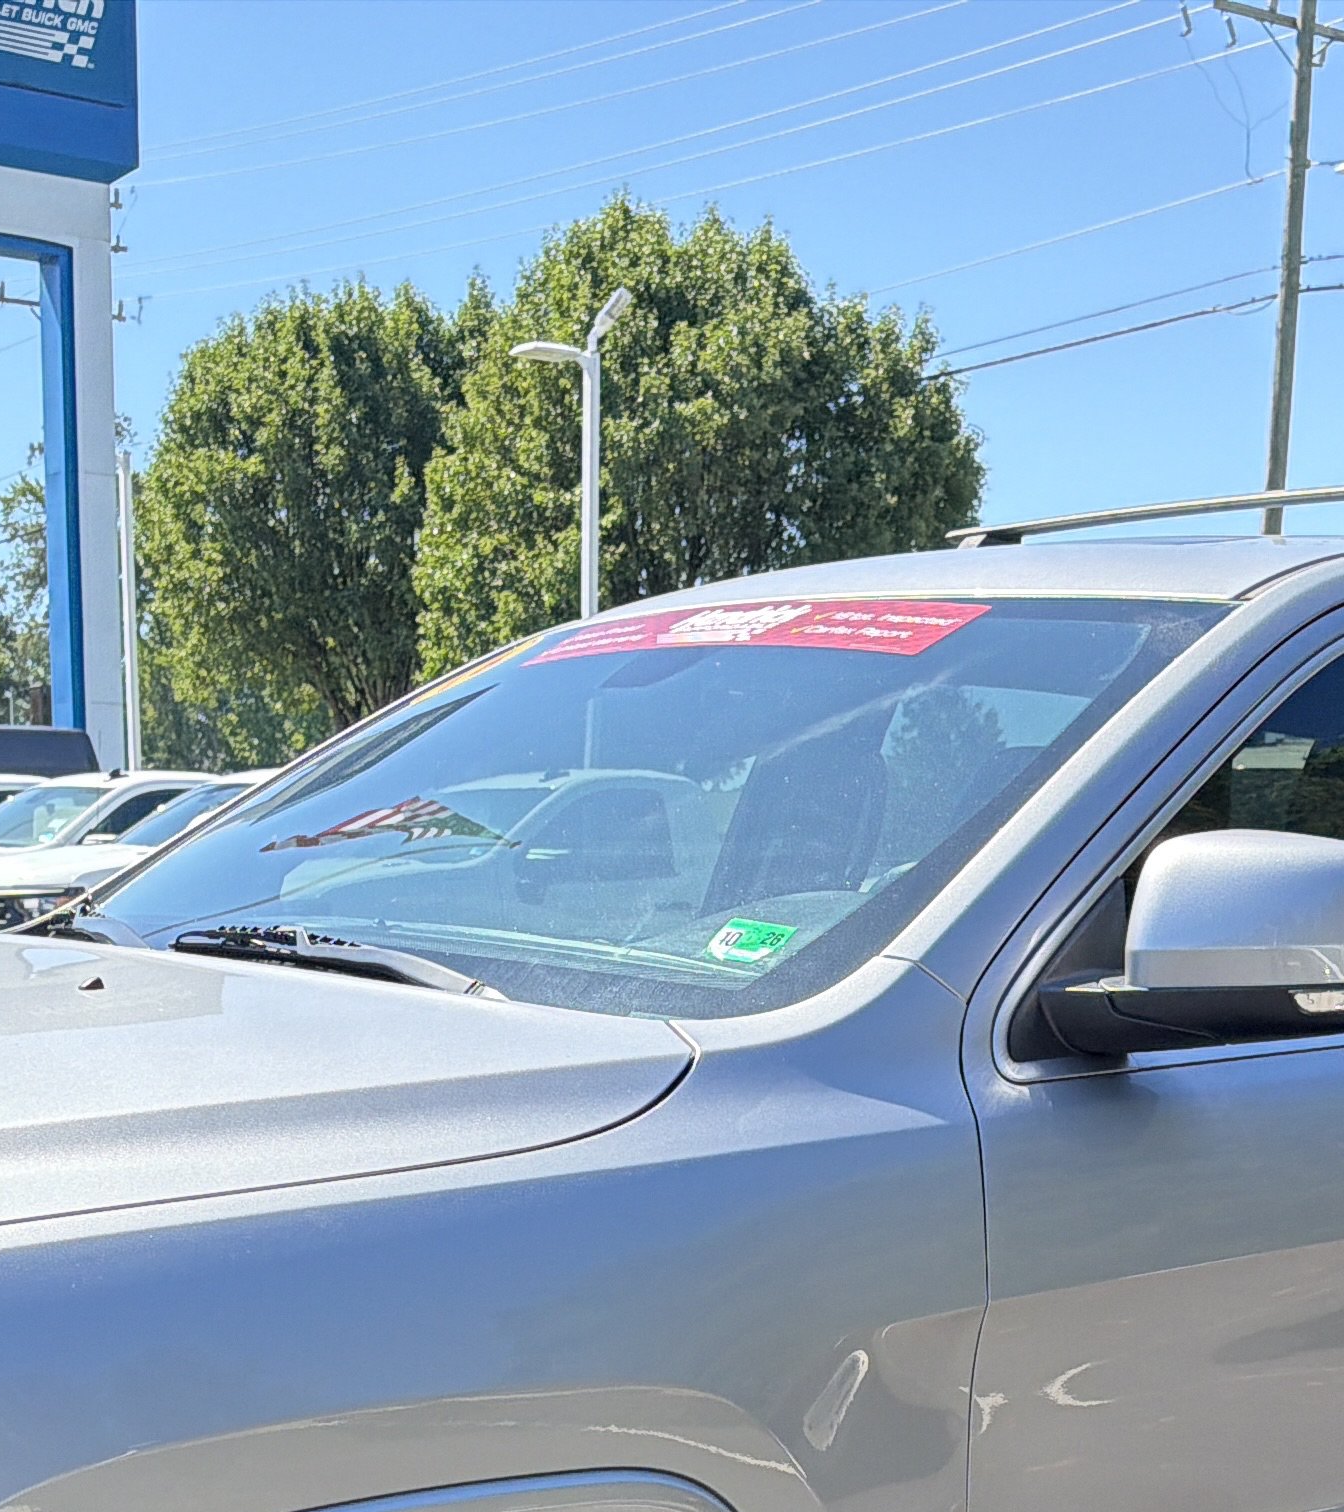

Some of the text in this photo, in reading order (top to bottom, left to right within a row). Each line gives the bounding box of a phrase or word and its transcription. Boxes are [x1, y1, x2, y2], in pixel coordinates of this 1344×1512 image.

[21, 7, 64, 28] BUICK
[67, 17, 99, 35] GMC
[719, 930, 744, 947] 10
[759, 931, 785, 947] 26
